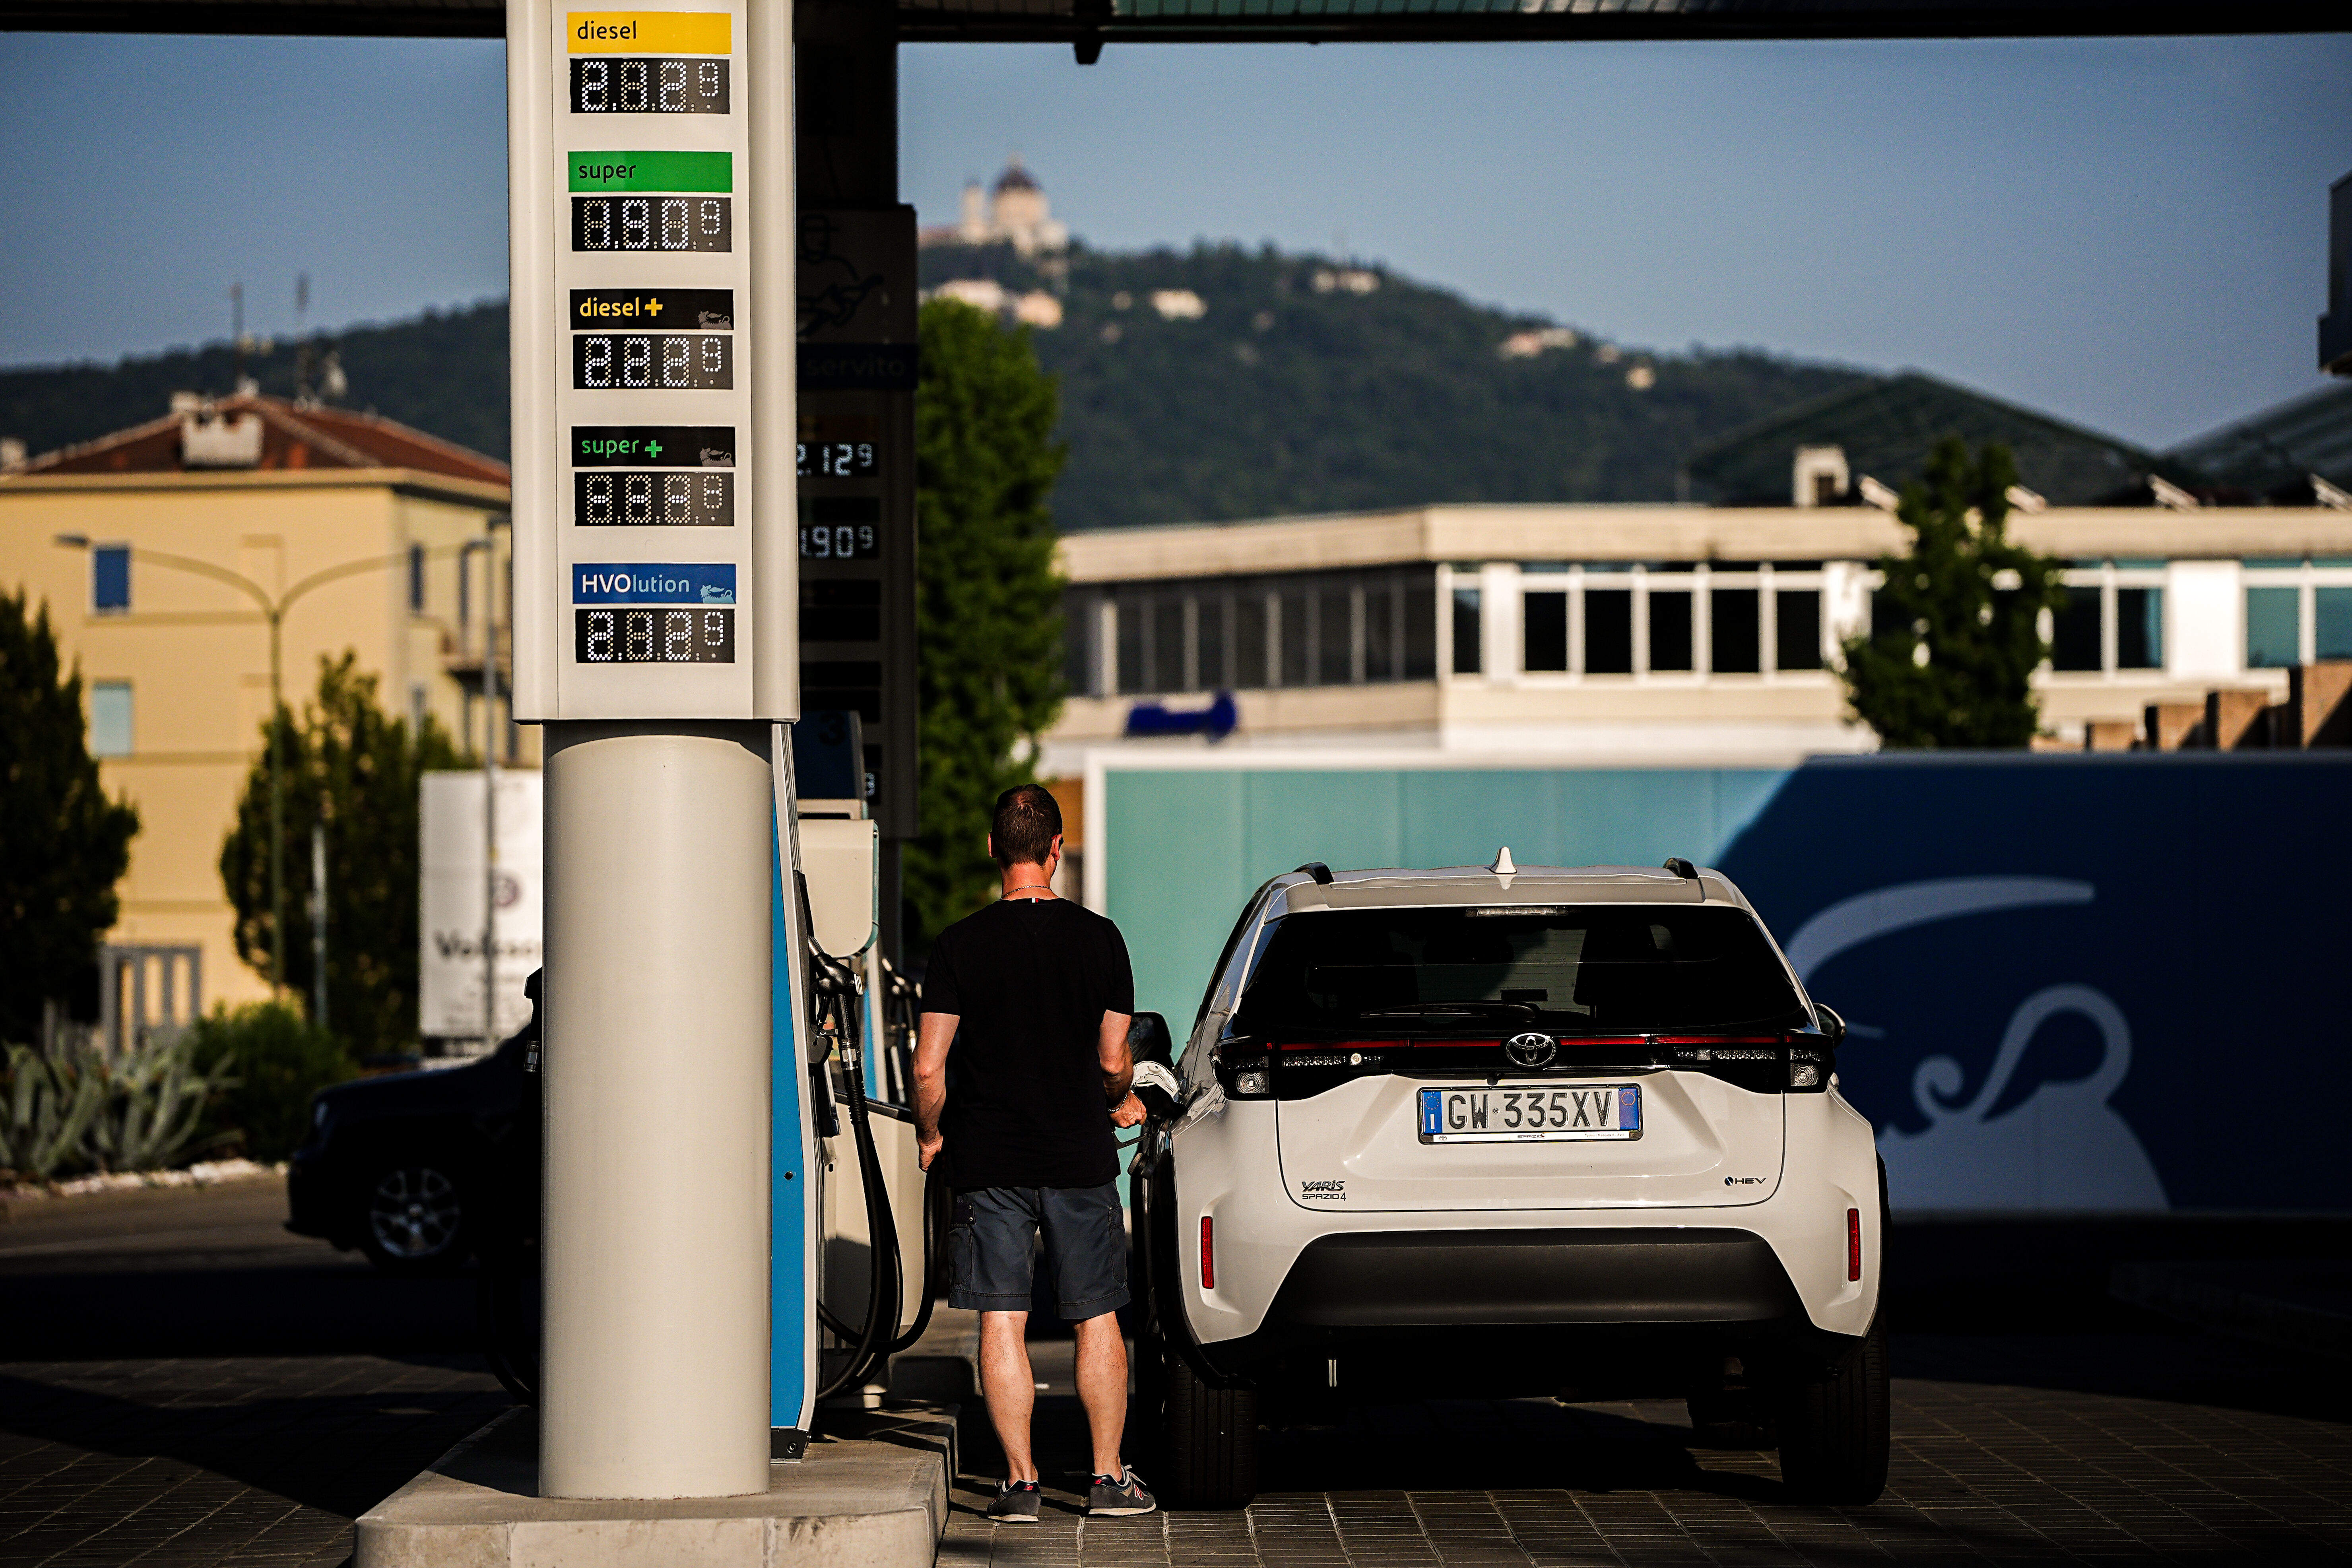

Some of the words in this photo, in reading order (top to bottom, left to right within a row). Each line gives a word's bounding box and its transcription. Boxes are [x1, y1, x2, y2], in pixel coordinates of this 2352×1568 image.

[578, 20, 636, 39] diesel
[578, 165, 636, 183] super
[582, 574, 689, 593] HVOlution
